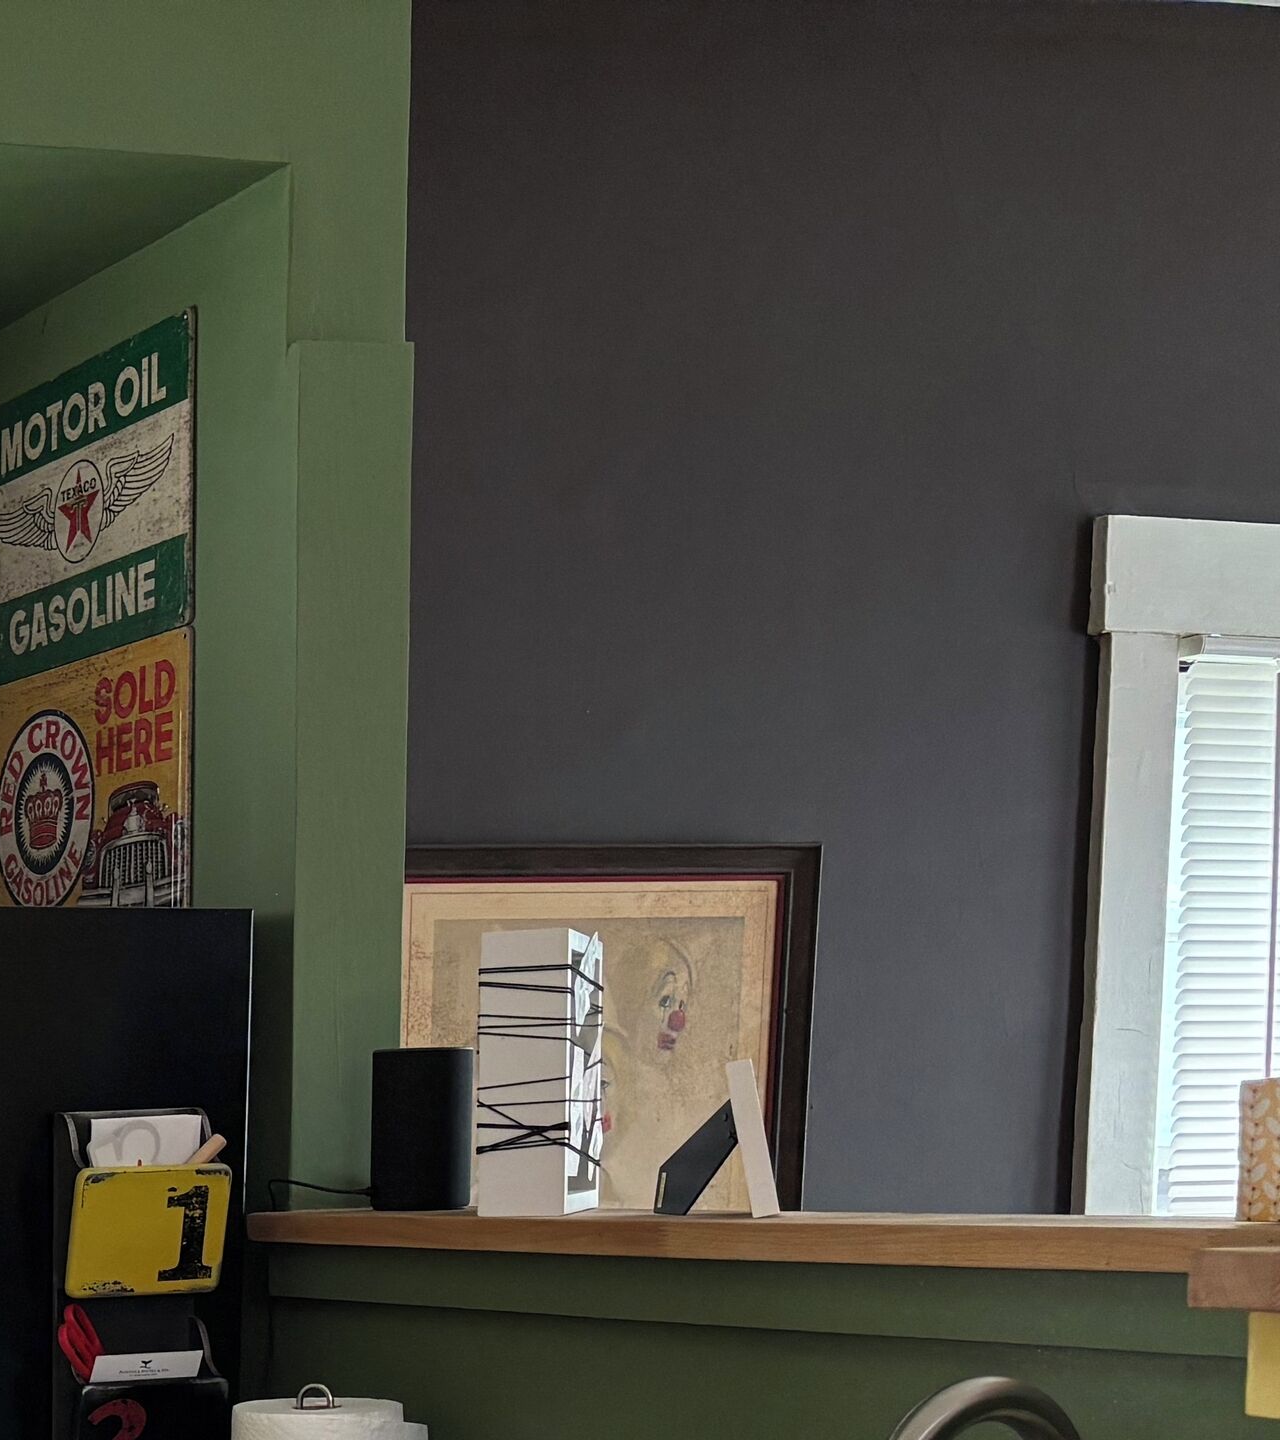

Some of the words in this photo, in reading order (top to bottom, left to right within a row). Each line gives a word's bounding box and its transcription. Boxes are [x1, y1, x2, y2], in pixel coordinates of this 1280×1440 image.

[1, 381, 107, 478] MOTOR
[114, 352, 167, 417] OIL
[61, 478, 96, 501] TEXACO
[9, 559, 156, 656] GASOLINE
[95, 659, 176, 725] SOLD
[0, 751, 25, 836] RED
[28, 720, 91, 820] CROWN
[95, 711, 173, 777] HERE
[4, 843, 83, 906] GASOLINE
[157, 1185, 212, 1281] 1
